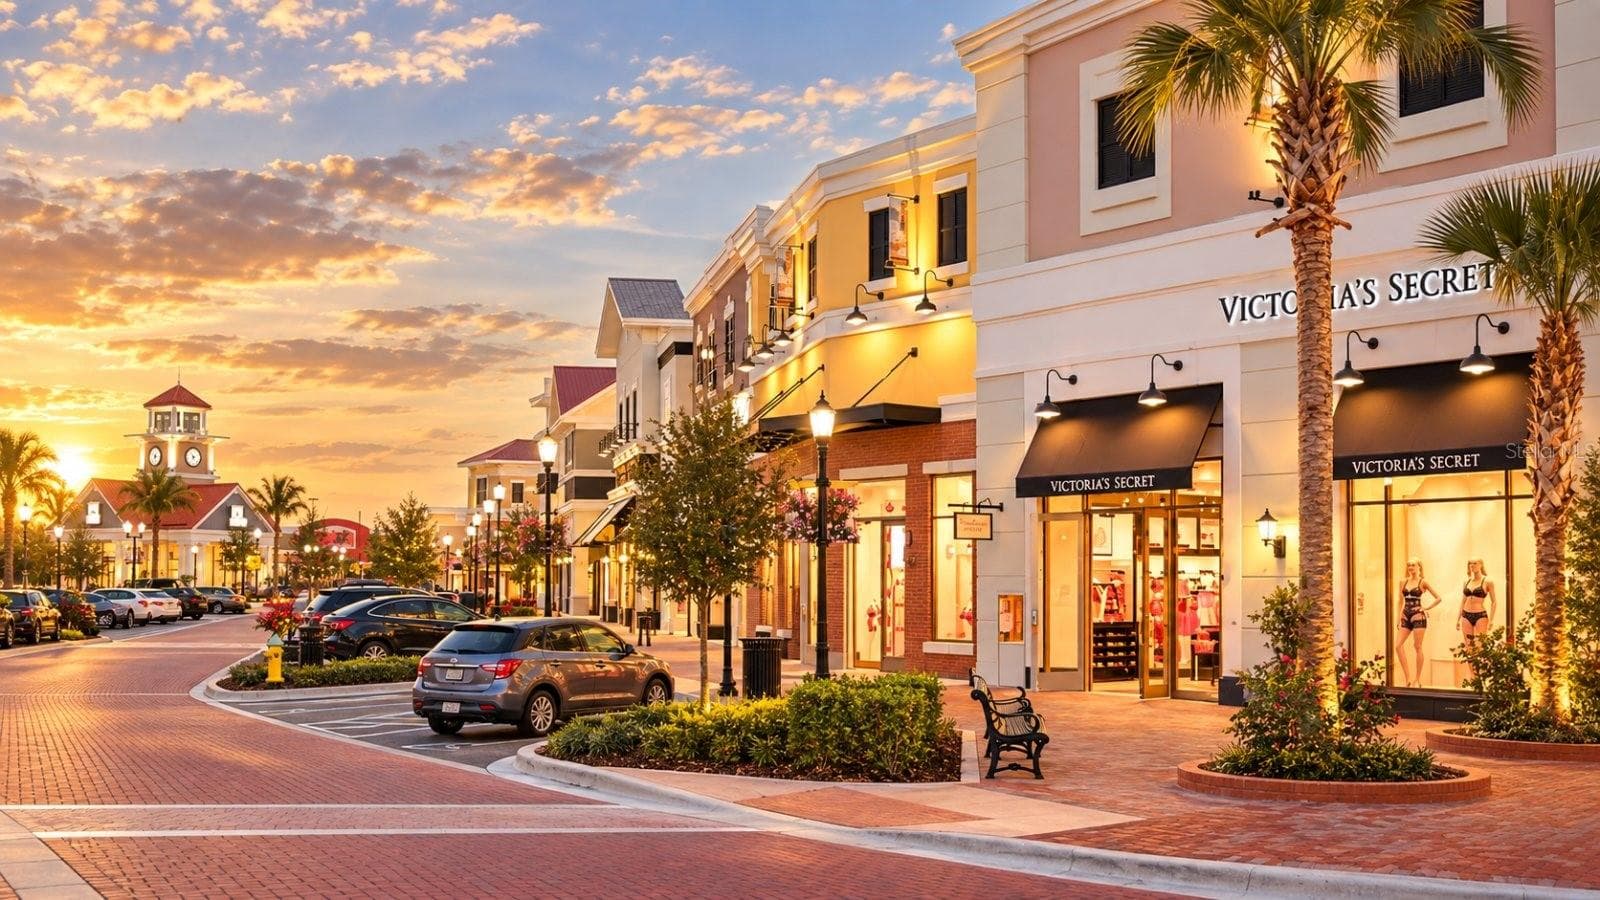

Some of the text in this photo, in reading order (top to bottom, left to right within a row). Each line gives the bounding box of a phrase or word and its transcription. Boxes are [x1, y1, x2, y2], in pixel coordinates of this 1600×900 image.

[1219, 261, 1495, 323] VICTOIA'S SECRET
[1352, 453, 1480, 474] VICTORIA'S SECRET
[1050, 474, 1155, 492] VICTORIA'S SECRET
